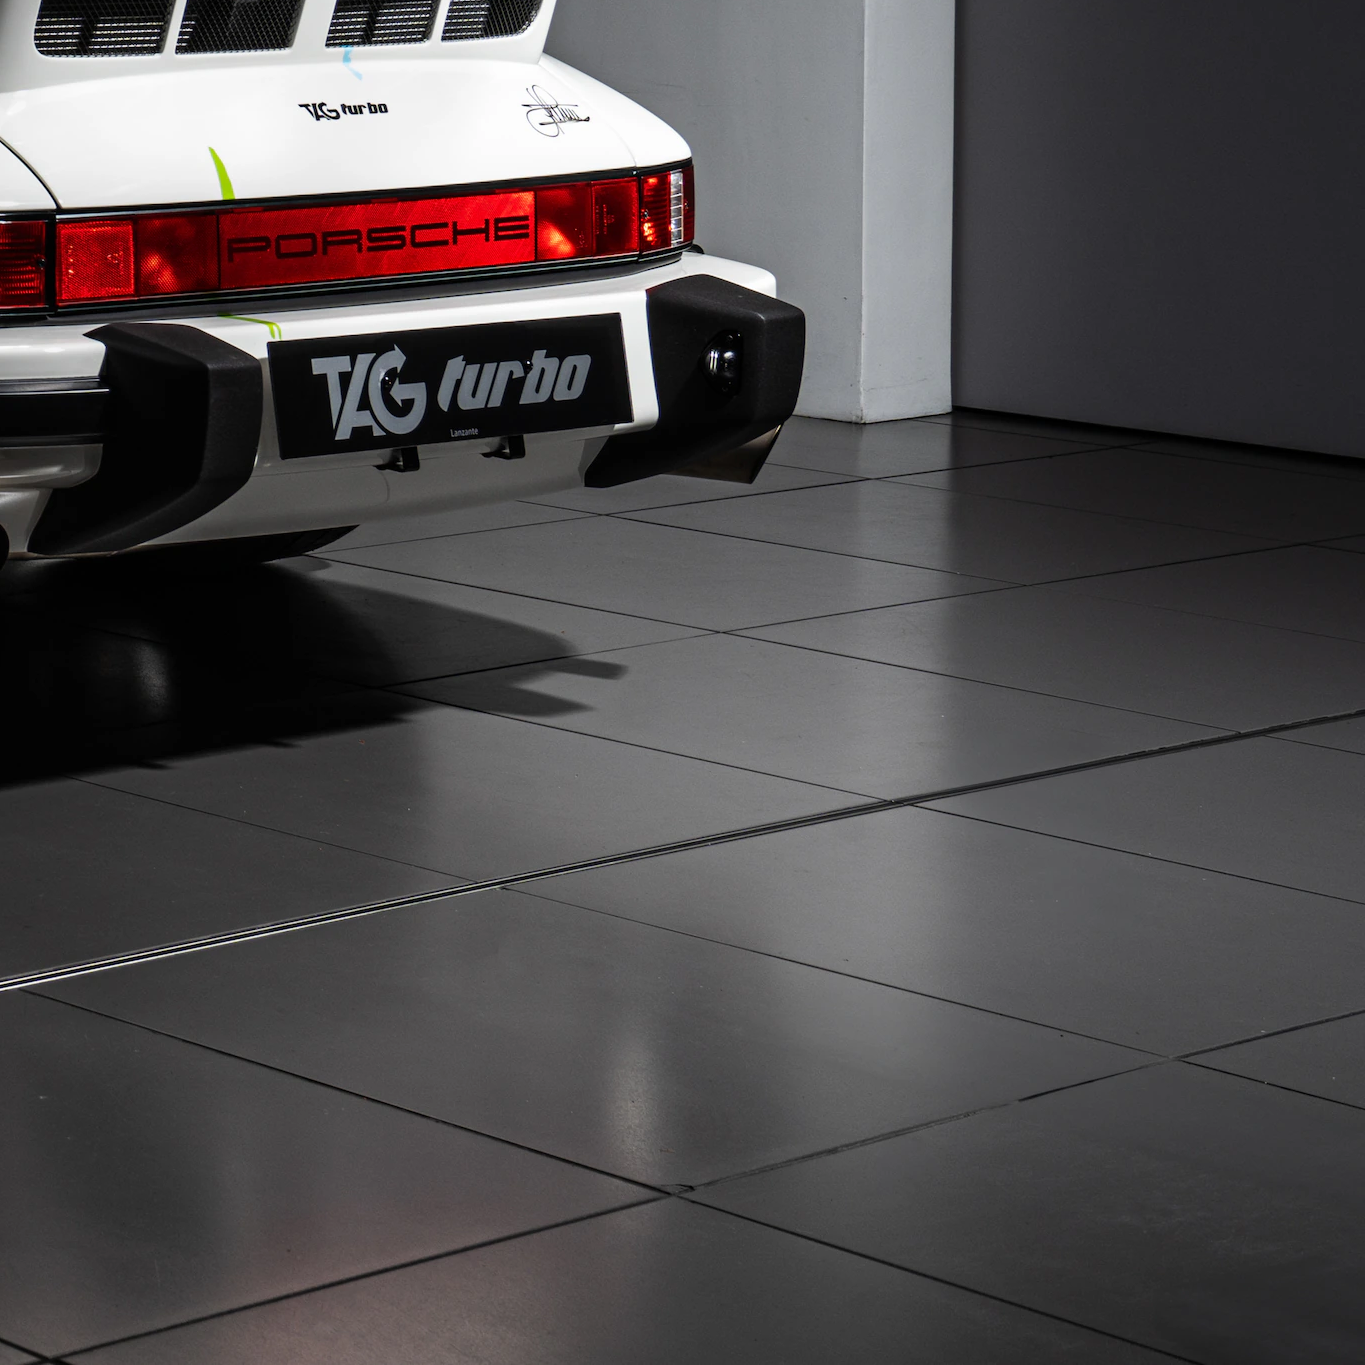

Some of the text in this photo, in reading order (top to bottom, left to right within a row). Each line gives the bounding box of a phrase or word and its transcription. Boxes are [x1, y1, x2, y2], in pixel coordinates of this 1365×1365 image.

[298, 102, 389, 122] TAG turbo
[227, 215, 530, 263] PORSCHE
[311, 344, 592, 441] TAG turbo
[450, 428, 479, 438] Lanzante
